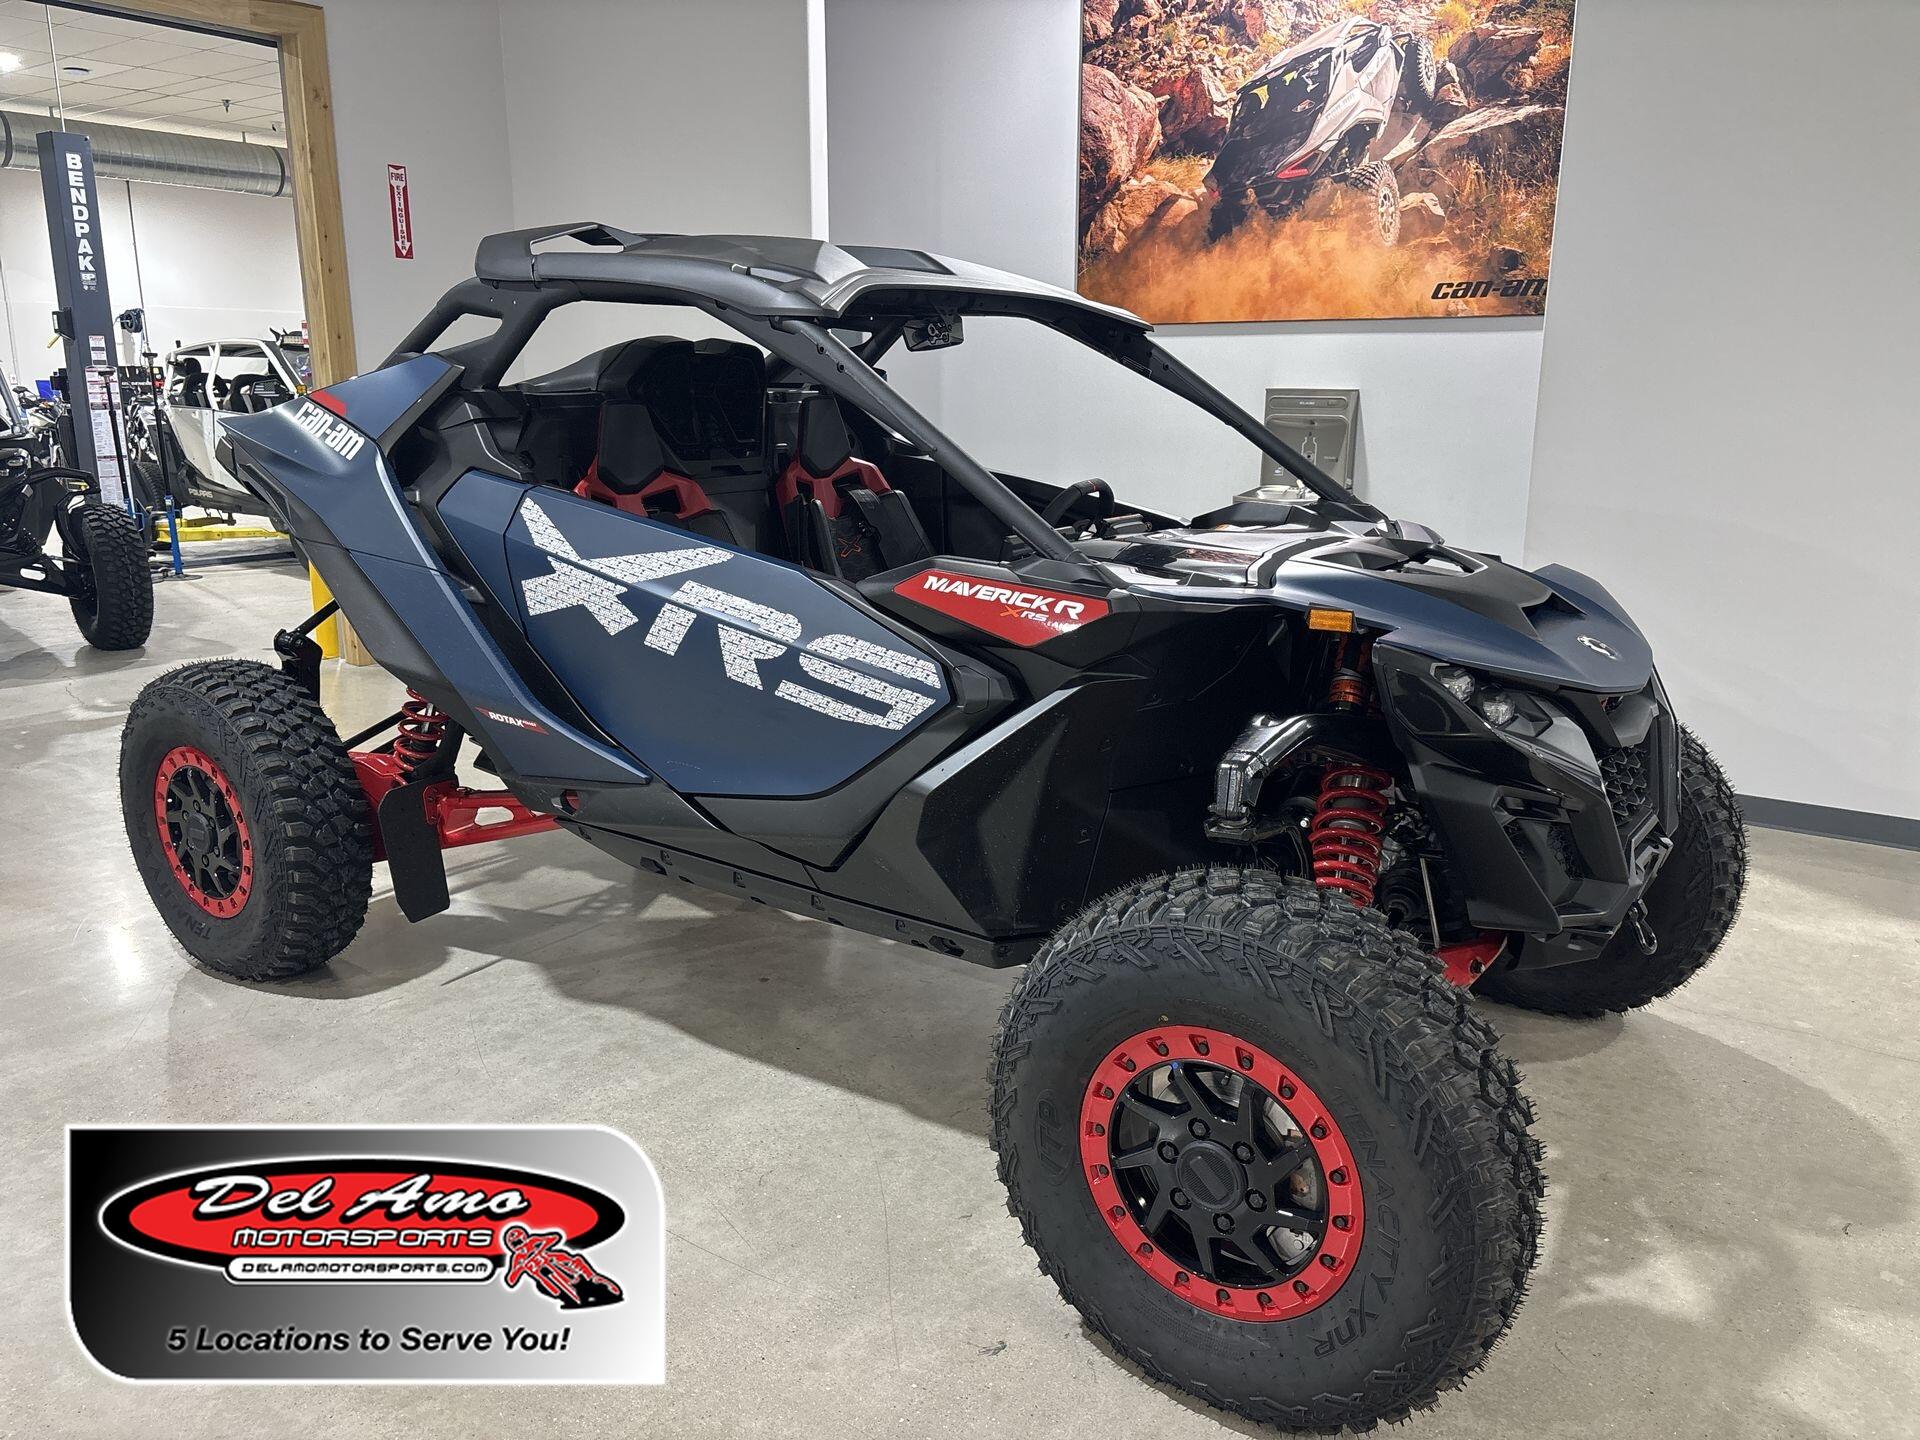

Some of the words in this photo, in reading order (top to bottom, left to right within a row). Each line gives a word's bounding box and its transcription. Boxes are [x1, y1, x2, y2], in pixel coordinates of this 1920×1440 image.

[390, 172, 405, 182] FIRE
[65, 152, 96, 271] BENDPAK
[396, 185, 407, 251] EXTINGUISHER
[293, 401, 365, 461] can-am
[520, 497, 942, 731] XRS
[923, 575, 1056, 612] MAVERICK
[1053, 600, 1085, 620] R
[1000, 605, 1050, 622] XRS
[488, 711, 525, 728] ROTAX
